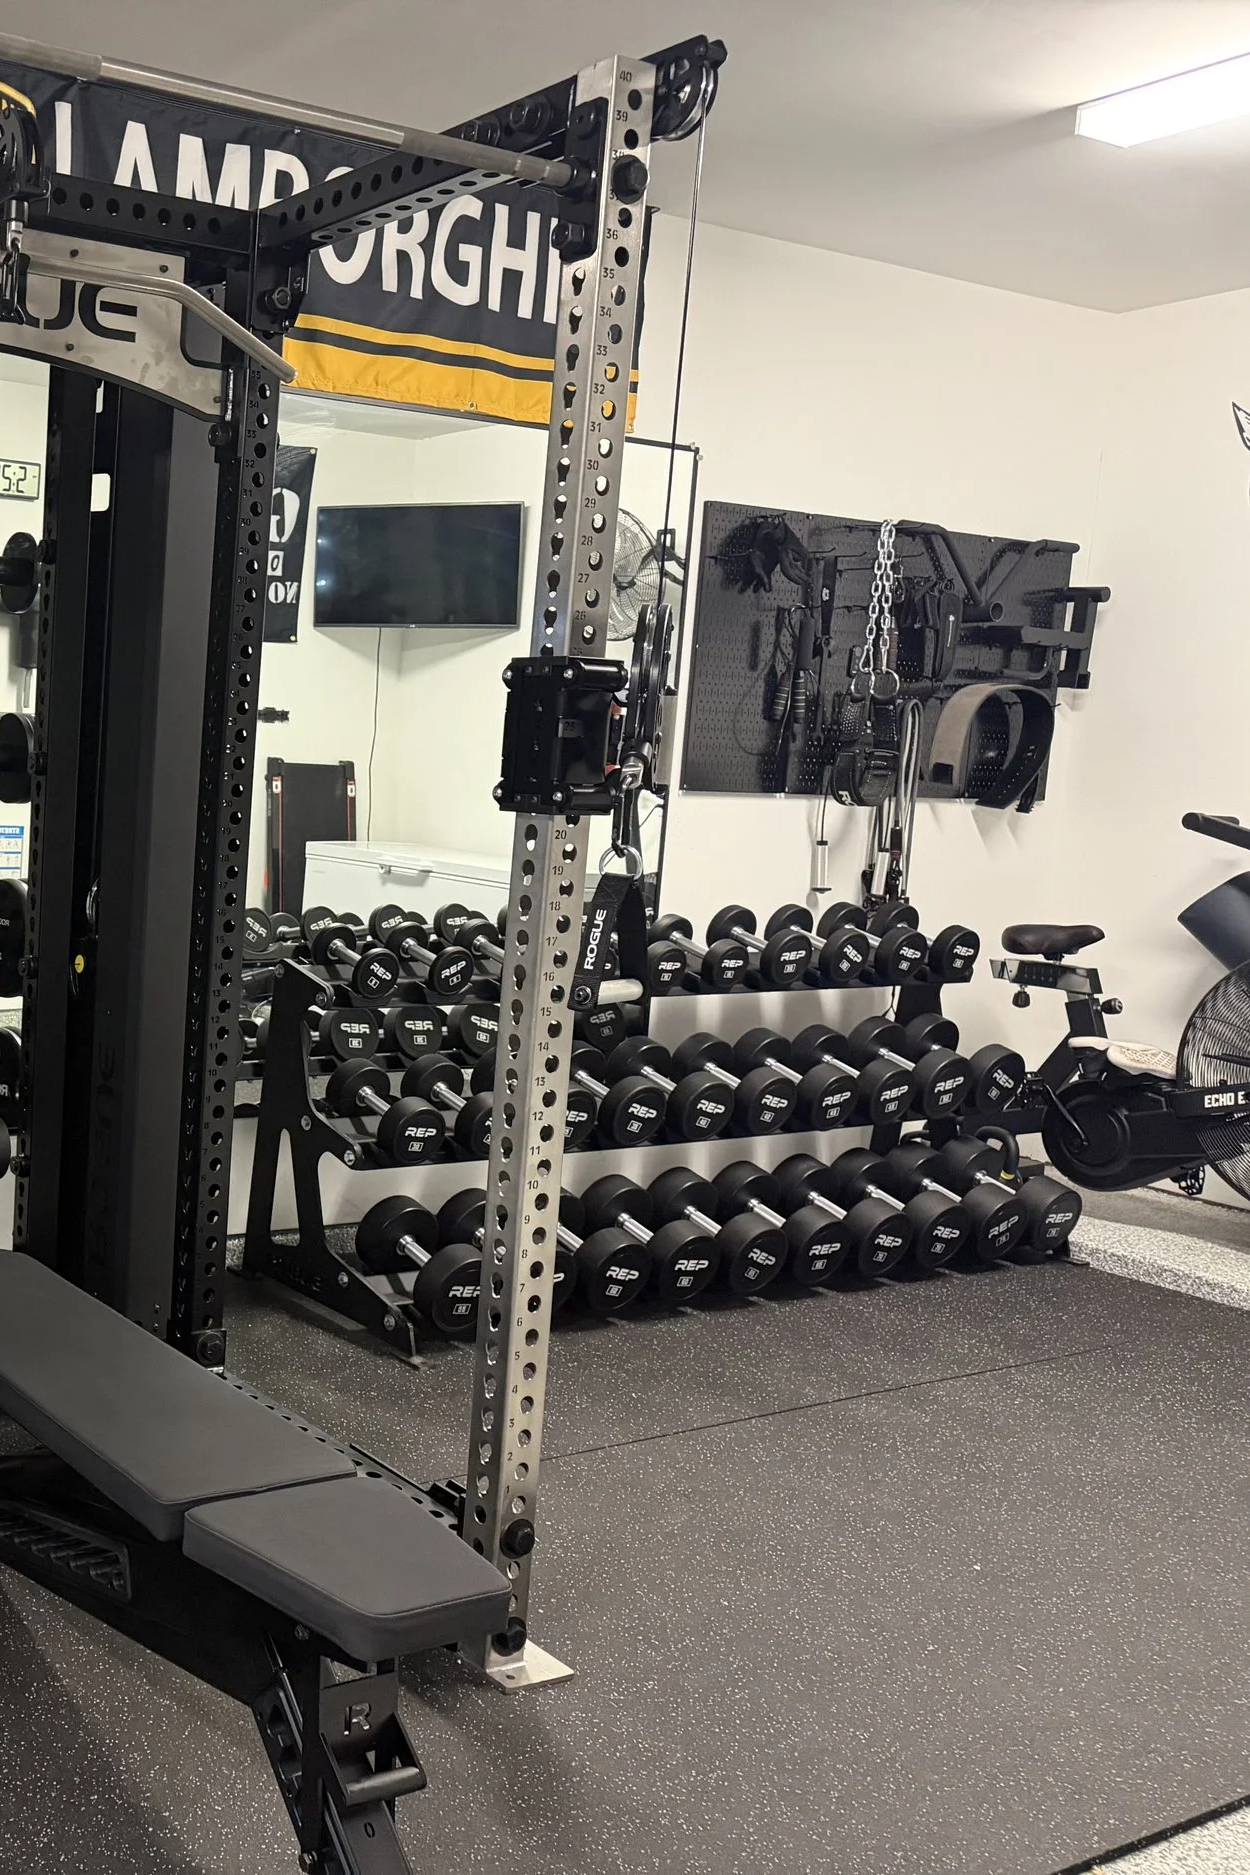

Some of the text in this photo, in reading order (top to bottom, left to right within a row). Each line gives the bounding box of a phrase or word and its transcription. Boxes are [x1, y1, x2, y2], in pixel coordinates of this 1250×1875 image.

[620, 70, 632, 82] 40
[616, 110, 628, 122] 39
[606, 228, 618, 240] 36
[602, 267, 614, 279] 35
[600, 306, 611, 318] 34
[596, 345, 608, 356] 33
[593, 383, 605, 395] 32
[590, 421, 601, 432] 31
[586, 460, 599, 470] 30
[584, 498, 596, 508] 29
[581, 535, 592, 546] 28
[578, 573, 589, 584] 27
[574, 610, 586, 621] 26
[554, 830, 566, 840] 20
[552, 866, 563, 876] 19
[550, 901, 560, 911] 18
[546, 936, 557, 946] 17
[584, 909, 607, 970] ROGUE
[781, 950, 806, 962] REP
[843, 944, 862, 962] REP
[900, 946, 921, 960] REP
[953, 945, 974, 957] REP
[659, 962, 680, 970] REP
[722, 960, 743, 968] REP
[370, 962, 392, 980] REP
[441, 961, 466, 979] REP
[543, 972, 554, 982] 16
[540, 1007, 551, 1016] 15
[538, 1042, 549, 1052] 14
[535, 1077, 545, 1086] 13
[992, 1069, 1014, 1088] REP
[934, 1076, 964, 1093] REP
[822, 1091, 851, 1106] REP
[880, 1086, 908, 1100] REP
[761, 1094, 788, 1108] REP
[1204, 1093, 1234, 1108] ECHO
[628, 1103, 657, 1118] REP
[697, 1100, 725, 1114] REP
[532, 1111, 543, 1121] 12
[405, 1127, 437, 1138] REP
[529, 1146, 540, 1156] 11
[528, 1180, 538, 1190] 10
[524, 1214, 530, 1225] 9
[1046, 1213, 1073, 1224] REP
[988, 1215, 1018, 1238] REP
[933, 1226, 960, 1239] REP
[875, 1234, 902, 1248] REP
[522, 1249, 528, 1258] 8
[810, 1244, 841, 1256] REP
[749, 1248, 776, 1266] REP
[675, 1260, 709, 1271] REP
[606, 1266, 639, 1280] REP
[520, 1283, 525, 1293] 7
[517, 1318, 522, 1326] 6
[514, 1352, 520, 1360] 5
[512, 1385, 518, 1394] 4
[509, 1418, 514, 1428] 3
[508, 1452, 512, 1461] 2
[506, 1486, 509, 1494] 1
